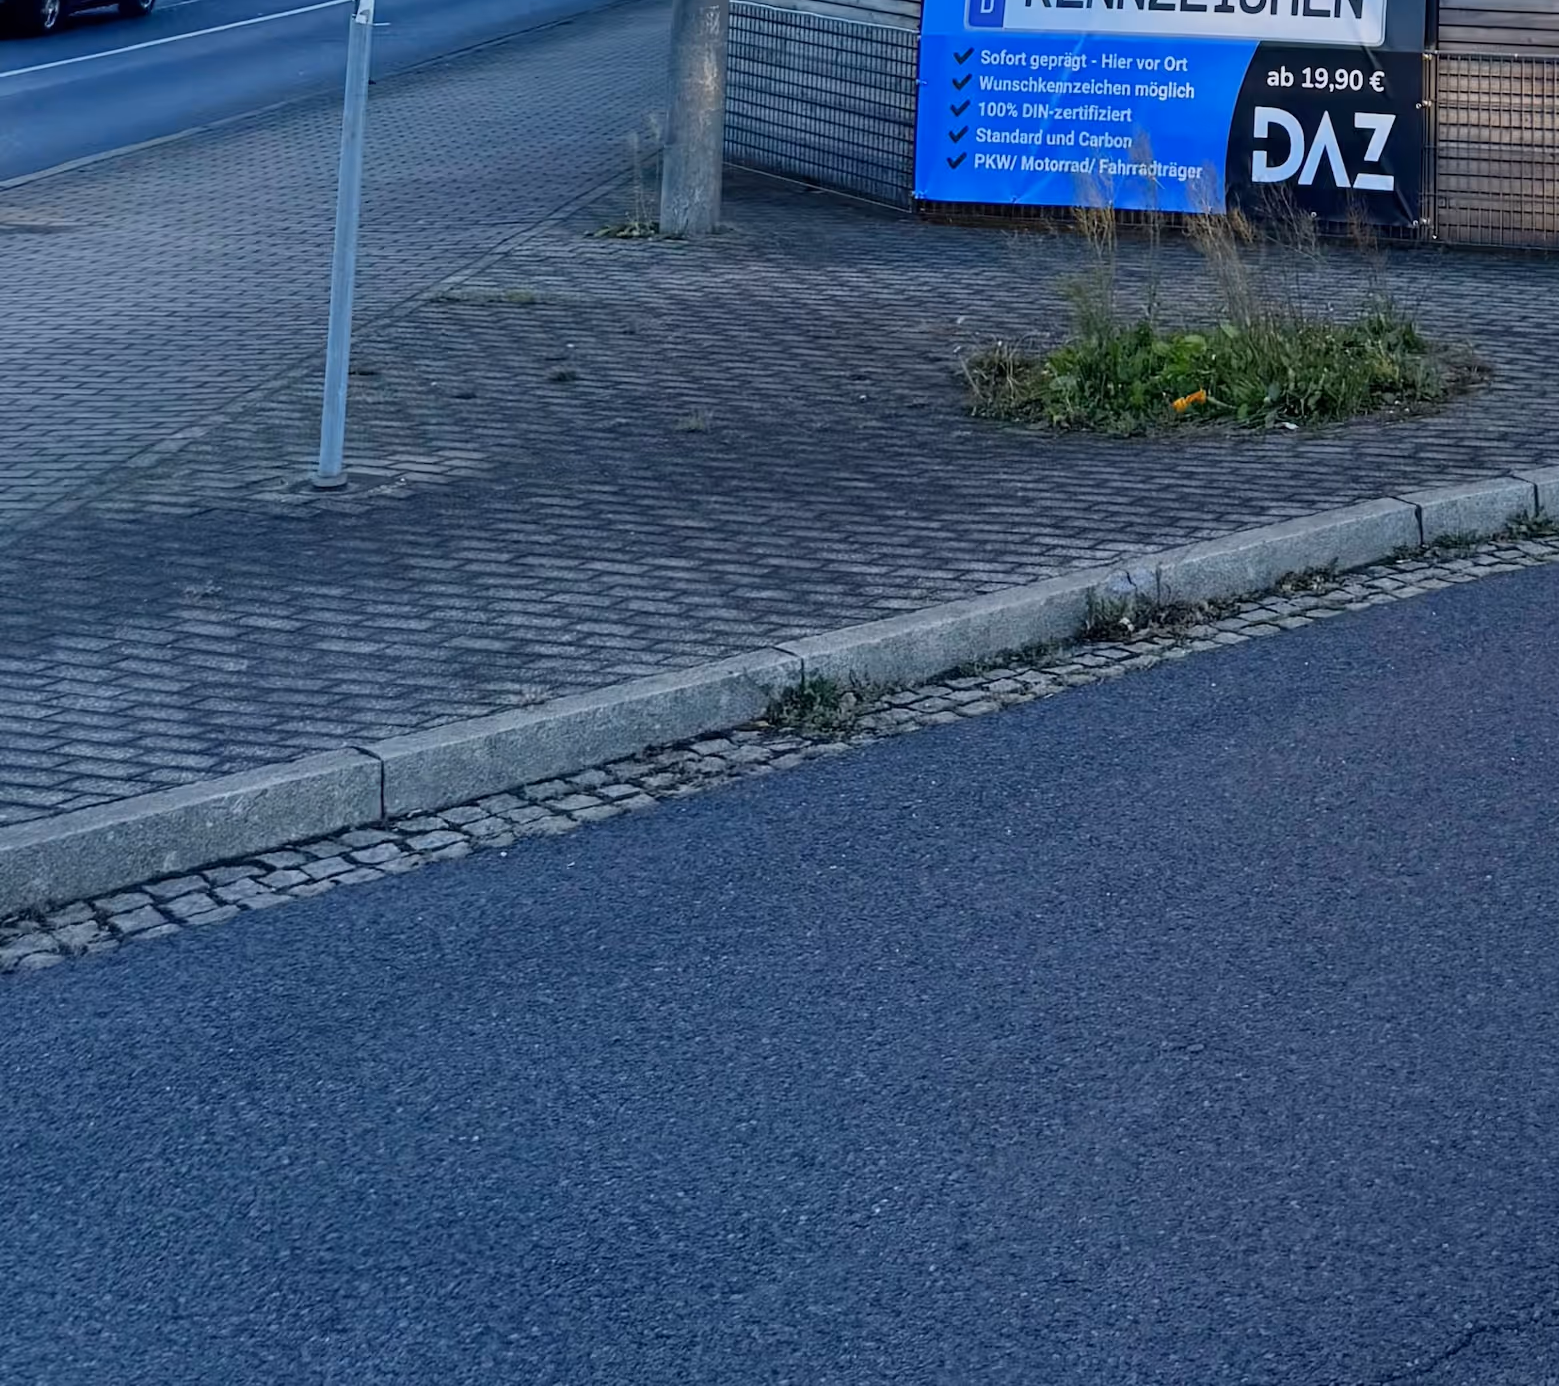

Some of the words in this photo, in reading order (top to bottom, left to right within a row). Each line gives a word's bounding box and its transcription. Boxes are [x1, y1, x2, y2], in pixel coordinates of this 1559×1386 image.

[981, 49, 1027, 66] Sofort
[1030, 51, 1087, 71] geprägt
[1101, 53, 1133, 70] Hier
[1136, 58, 1160, 71] vor
[1164, 56, 1188, 72] Ort
[979, 75, 1131, 96] Wunschkennzeichen
[1135, 81, 1195, 101] möglich
[1267, 65, 1294, 87] ab
[1301, 67, 1364, 93] 19,90
[1369, 70, 1386, 93] €
[978, 102, 1018, 118] 100%
[1022, 103, 1132, 122] DIN-zertifiziert
[975, 128, 1043, 145] Standard
[1046, 130, 1075, 146] und
[1078, 131, 1133, 149] Carbon
[1251, 106, 1397, 192] DAZ
[974, 153, 1017, 171] PKW/
[1020, 155, 1095, 174] Motorrad/
[1099, 159, 1203, 181] Fahrradträger
